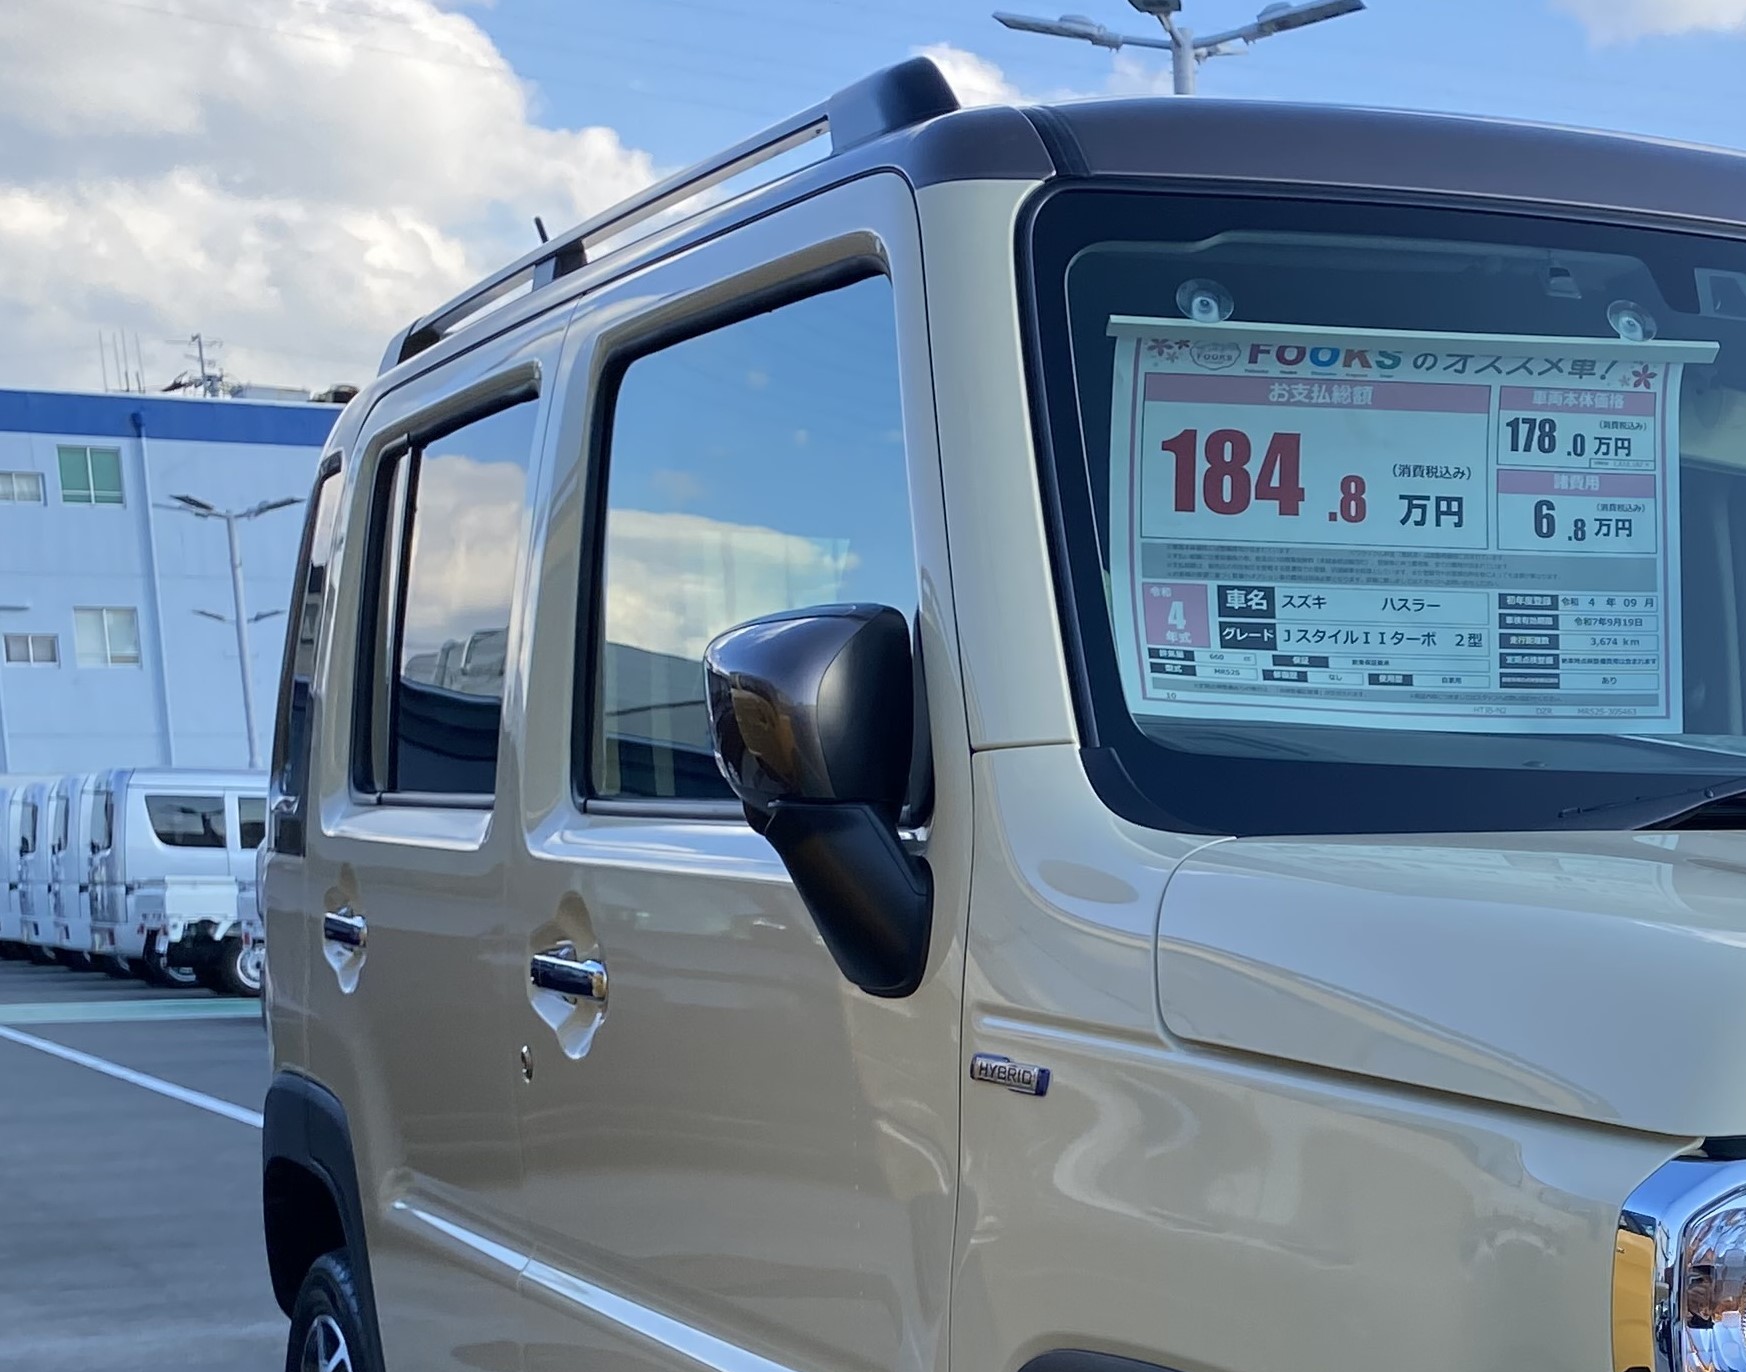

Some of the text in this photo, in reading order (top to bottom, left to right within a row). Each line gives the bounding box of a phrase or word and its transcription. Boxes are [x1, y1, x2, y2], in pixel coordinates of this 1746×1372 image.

[1248, 343, 1403, 371] FOOKS
[1268, 383, 1374, 405] お支払総額
[1594, 436, 1632, 457] 万円
[1392, 463, 1472, 480] (消費税込み)
[1398, 494, 1465, 528] 万円
[1594, 518, 1633, 538] 万円
[1225, 588, 1269, 611] 車名
[1281, 594, 1441, 612] スズキ ハスラー
[1167, 601, 1187, 630] 4
[1165, 630, 1192, 644] 年式
[1222, 626, 1275, 642] グレード
[1590, 637, 1618, 647] 3,674
[978, 1061, 1033, 1085] HYBRID
